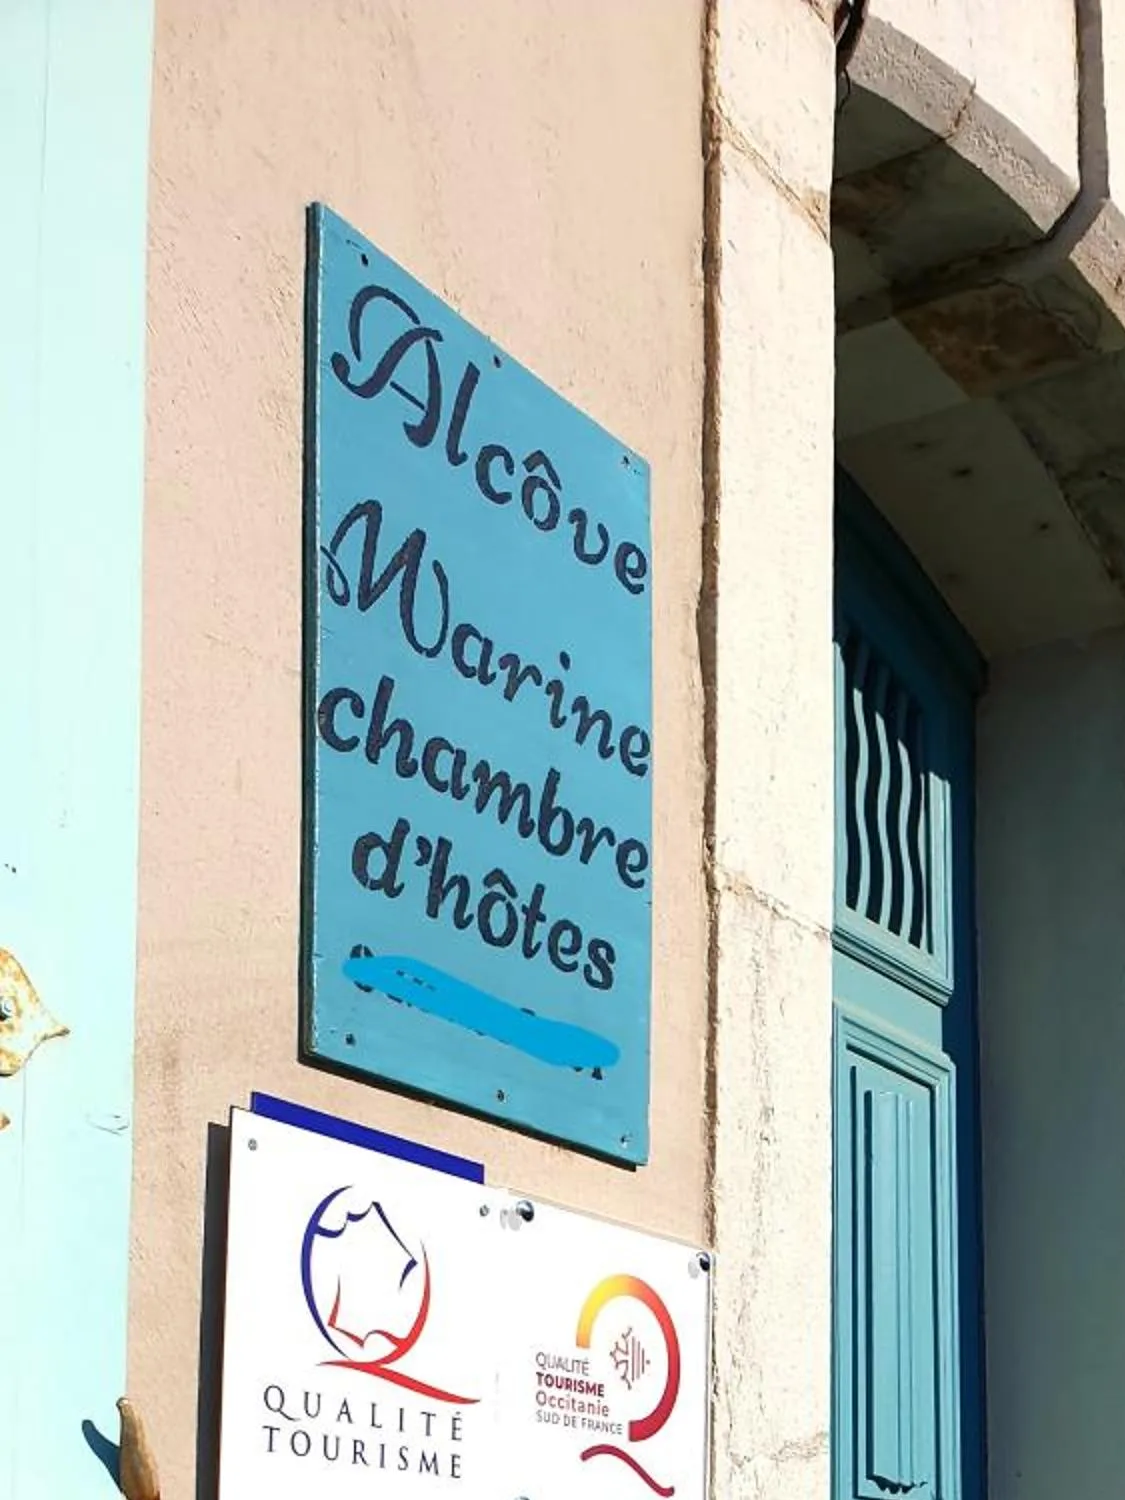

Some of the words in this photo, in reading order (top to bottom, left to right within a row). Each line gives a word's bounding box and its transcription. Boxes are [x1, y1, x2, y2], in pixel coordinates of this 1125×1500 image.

[331, 283, 648, 597] Alcôve
[319, 498, 652, 777] Marine
[317, 676, 650, 890] chambre
[351, 817, 617, 990] d'hôtes
[535, 1351, 590, 1376] QUALITÉ
[535, 1371, 605, 1398] TOURISME
[262, 1384, 464, 1442] QUALITÉ
[535, 1390, 610, 1417] Occitanie
[535, 1409, 561, 1425] SUD
[563, 1413, 577, 1429] DE
[581, 1417, 623, 1435] FRANCE
[262, 1425, 463, 1480] TOURISME
